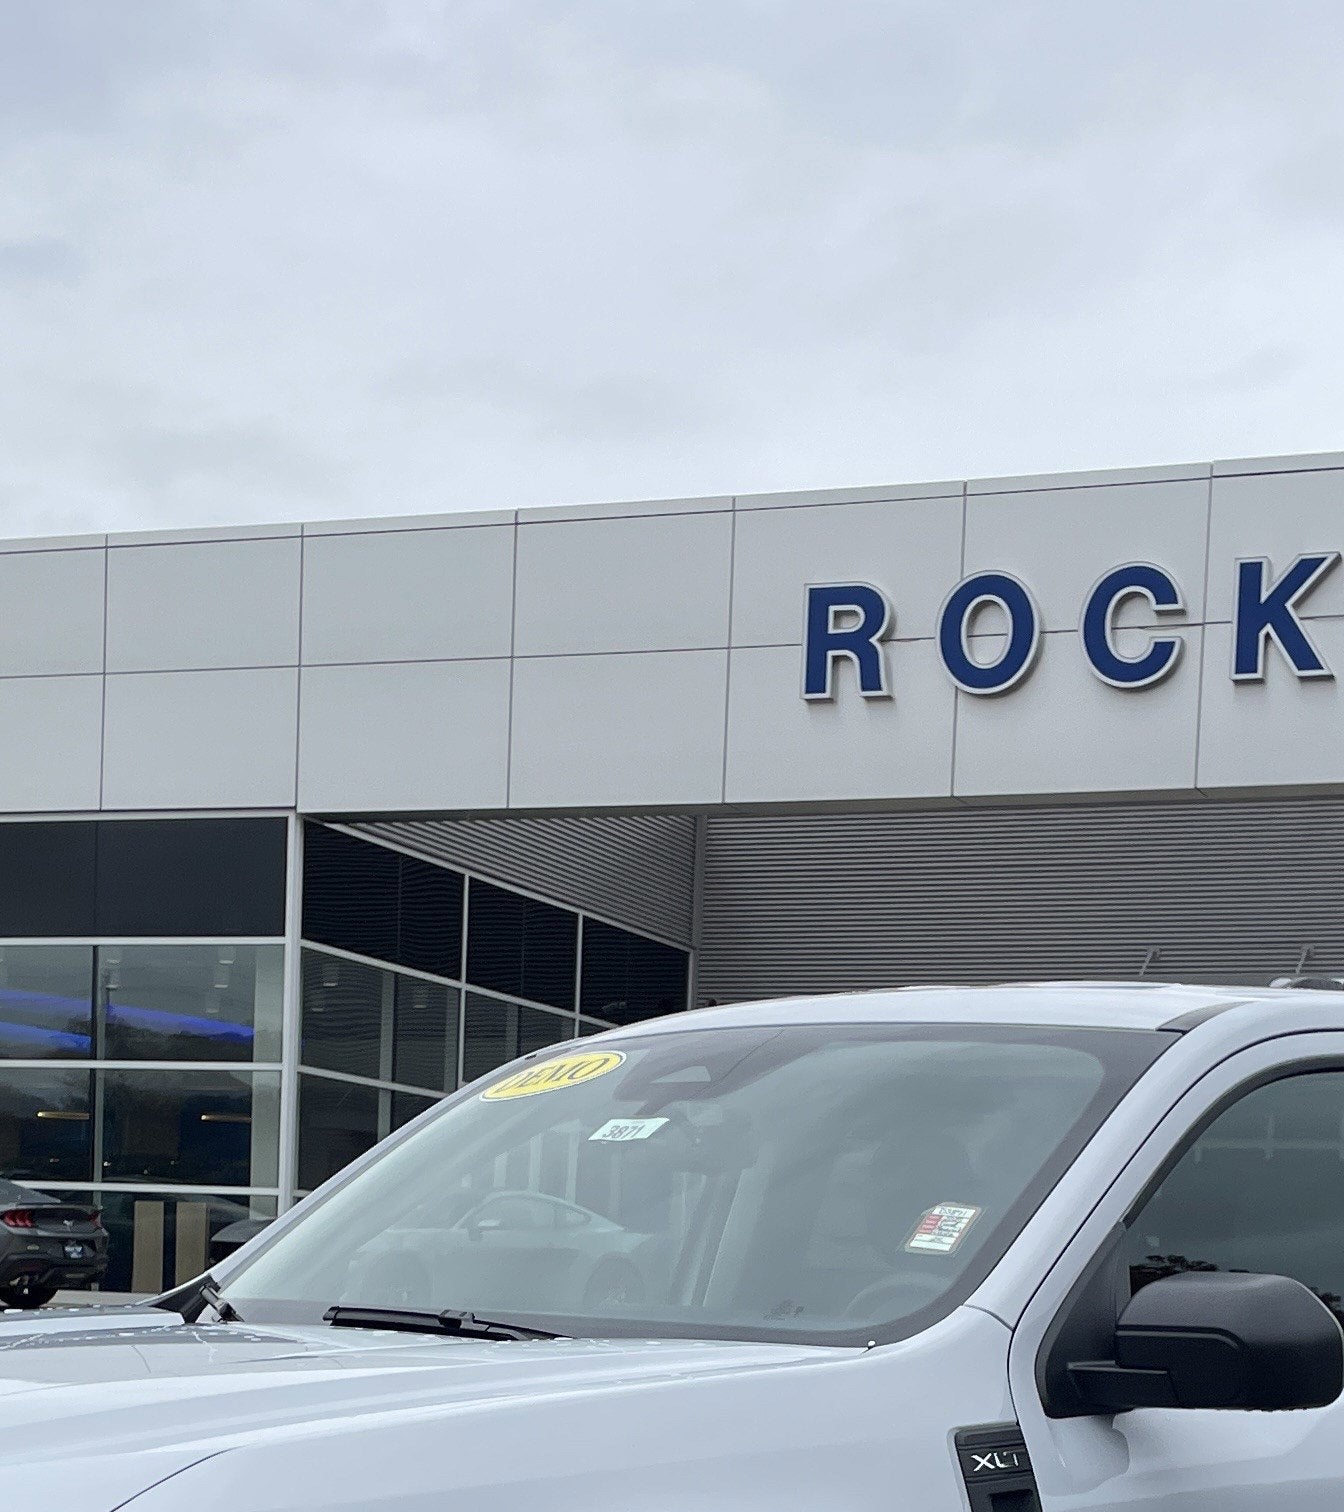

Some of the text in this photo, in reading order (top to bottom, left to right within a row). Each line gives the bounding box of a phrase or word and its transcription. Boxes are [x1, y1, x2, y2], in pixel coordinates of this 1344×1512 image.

[492, 1057, 611, 1095] DEMO
[601, 1124, 646, 1140] 3871
[970, 1450, 1026, 1472] XLT
